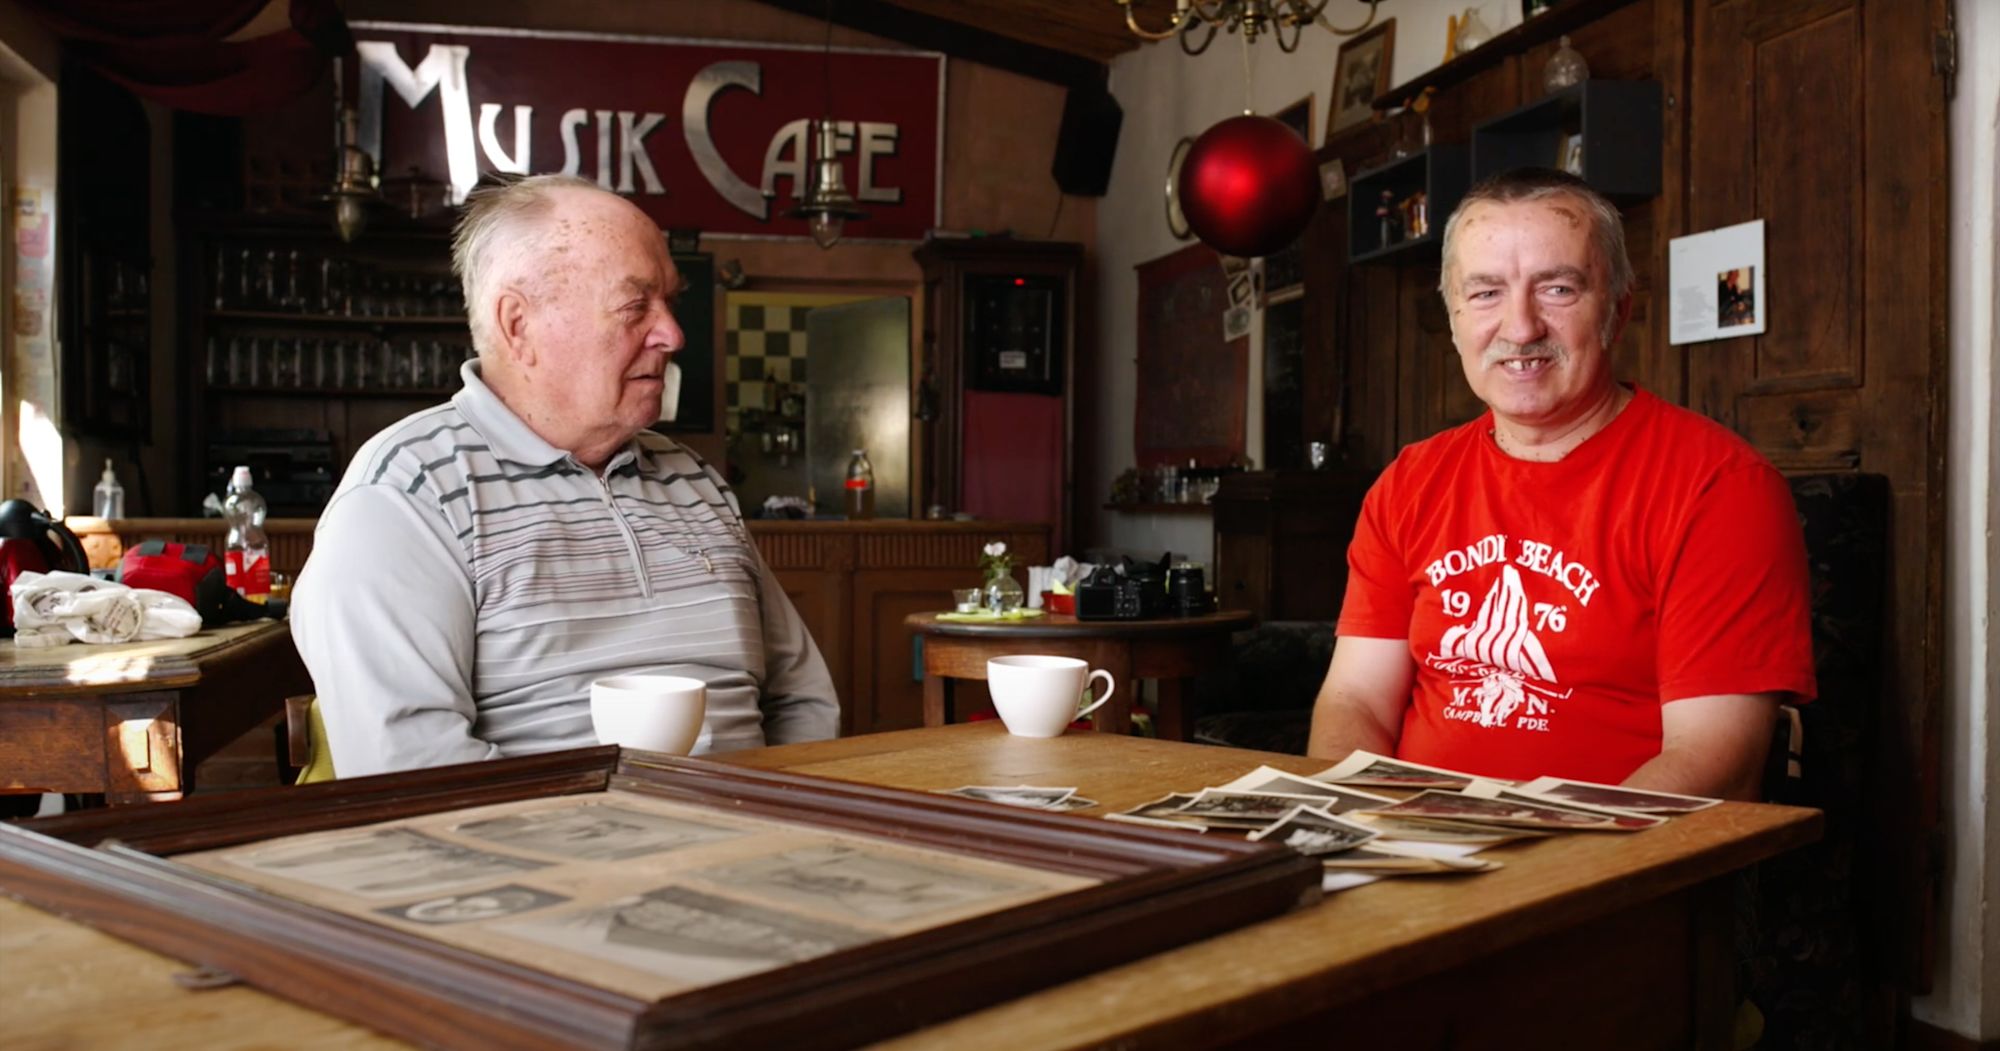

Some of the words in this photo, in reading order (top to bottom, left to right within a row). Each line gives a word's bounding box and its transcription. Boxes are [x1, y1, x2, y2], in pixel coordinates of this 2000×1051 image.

[356, 41, 666, 206] MUSIK
[683, 60, 901, 219] CAFE
[1425, 534, 1507, 587] BONDI
[1515, 540, 1600, 607] BEACH
[1441, 589, 1471, 617] 19
[1534, 602, 1567, 632] 76
